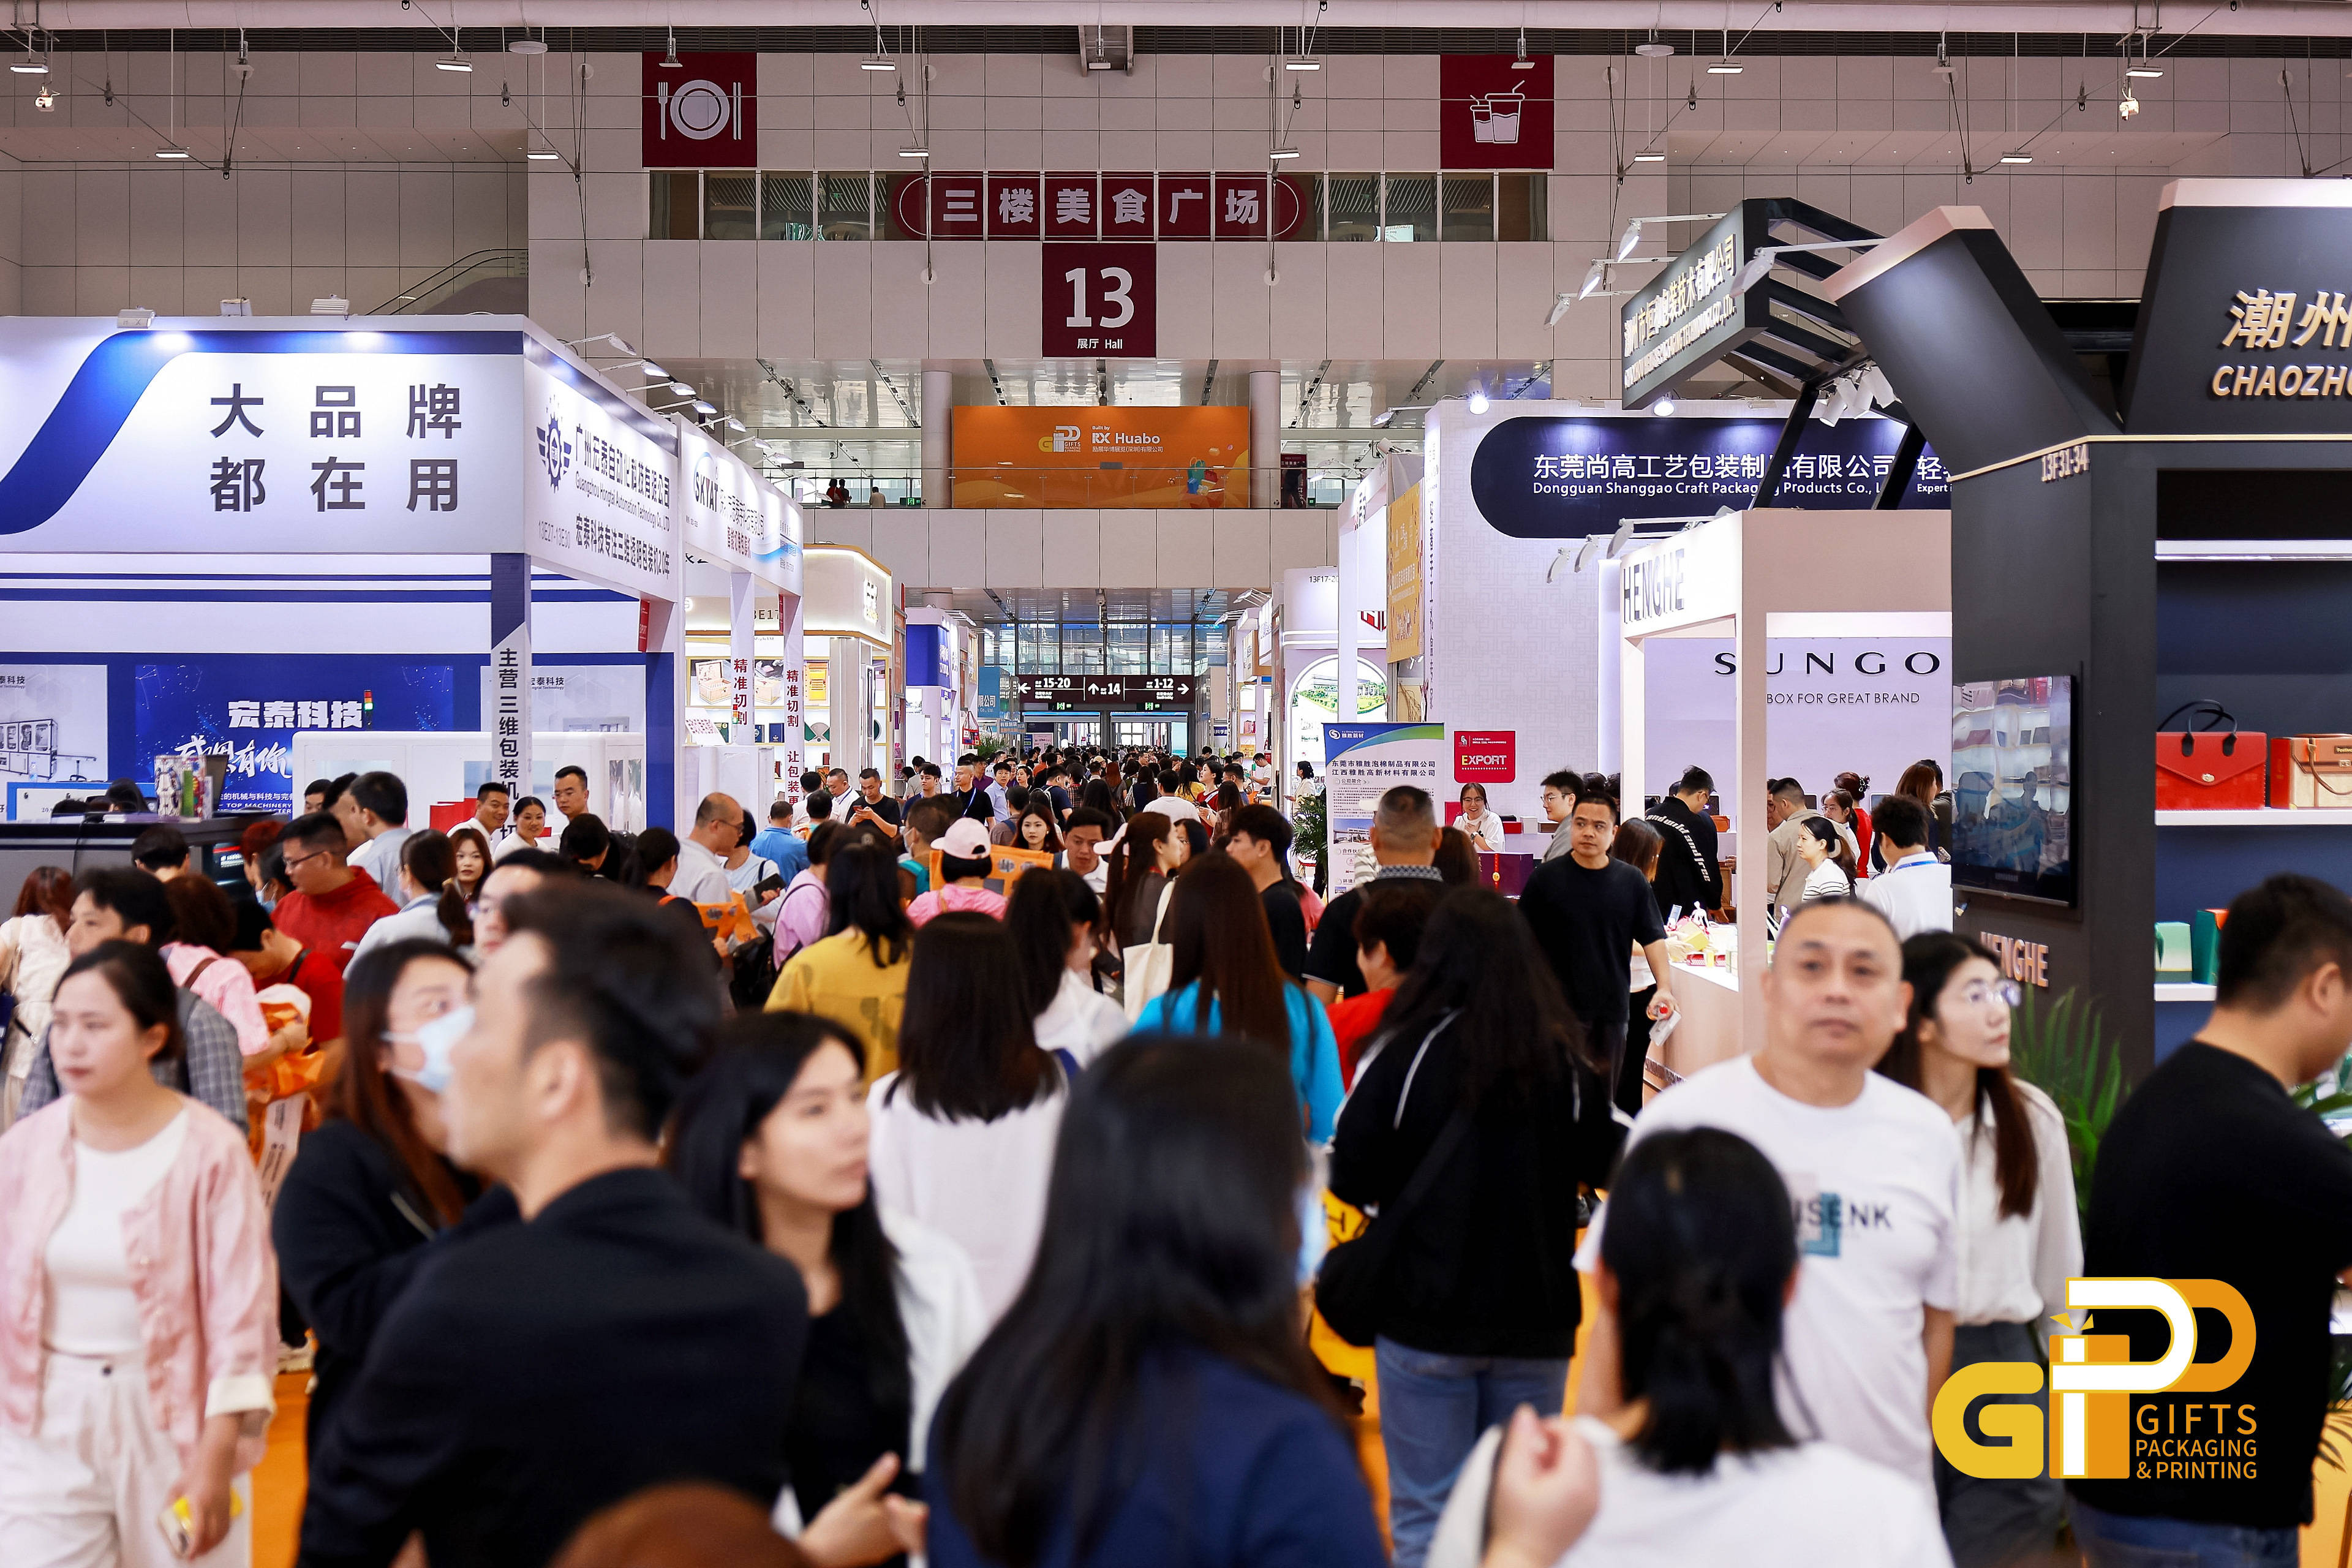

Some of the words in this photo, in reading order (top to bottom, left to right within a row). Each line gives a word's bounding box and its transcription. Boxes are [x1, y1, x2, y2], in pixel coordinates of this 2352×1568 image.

[944, 187, 1259, 224] 三楼美食广场
[1065, 267, 1134, 328] 13
[1077, 339, 1099, 350] 展厅
[1104, 339, 1123, 350] Hall
[2212, 364, 2352, 397] CHAOZH
[210, 383, 462, 439] 大品牌
[1092, 432, 1110, 444] RX
[1115, 432, 1160, 444] Huabo
[1533, 454, 1896, 480] 东莞尚高工艺包装制有限公司
[2041, 444, 2090, 483] 13F31-34
[210, 456, 458, 512] 都在用
[695, 472, 718, 512] SKYAT
[1533, 483, 1602, 497] Dongguan
[1606, 482, 1672, 497] Shanggao
[1676, 482, 1709, 494] Craft
[1784, 482, 1842, 494] Products
[1847, 483, 1872, 495] Co.,
[1917, 484, 1947, 494] Expert
[1624, 548, 1684, 624] HENGHE
[1043, 677, 1071, 688] 15-20
[1107, 683, 1121, 695] 14
[1154, 678, 1174, 688] 1-12
[786, 669, 799, 728] 精准切割
[1766, 693, 1793, 704] BOX
[1798, 693, 1823, 704] FOR
[1827, 693, 1870, 704] GREAT
[1874, 693, 1920, 704] BRAND
[228, 701, 363, 728] 宏泰科技
[1461, 755, 1507, 765] EXPORT
